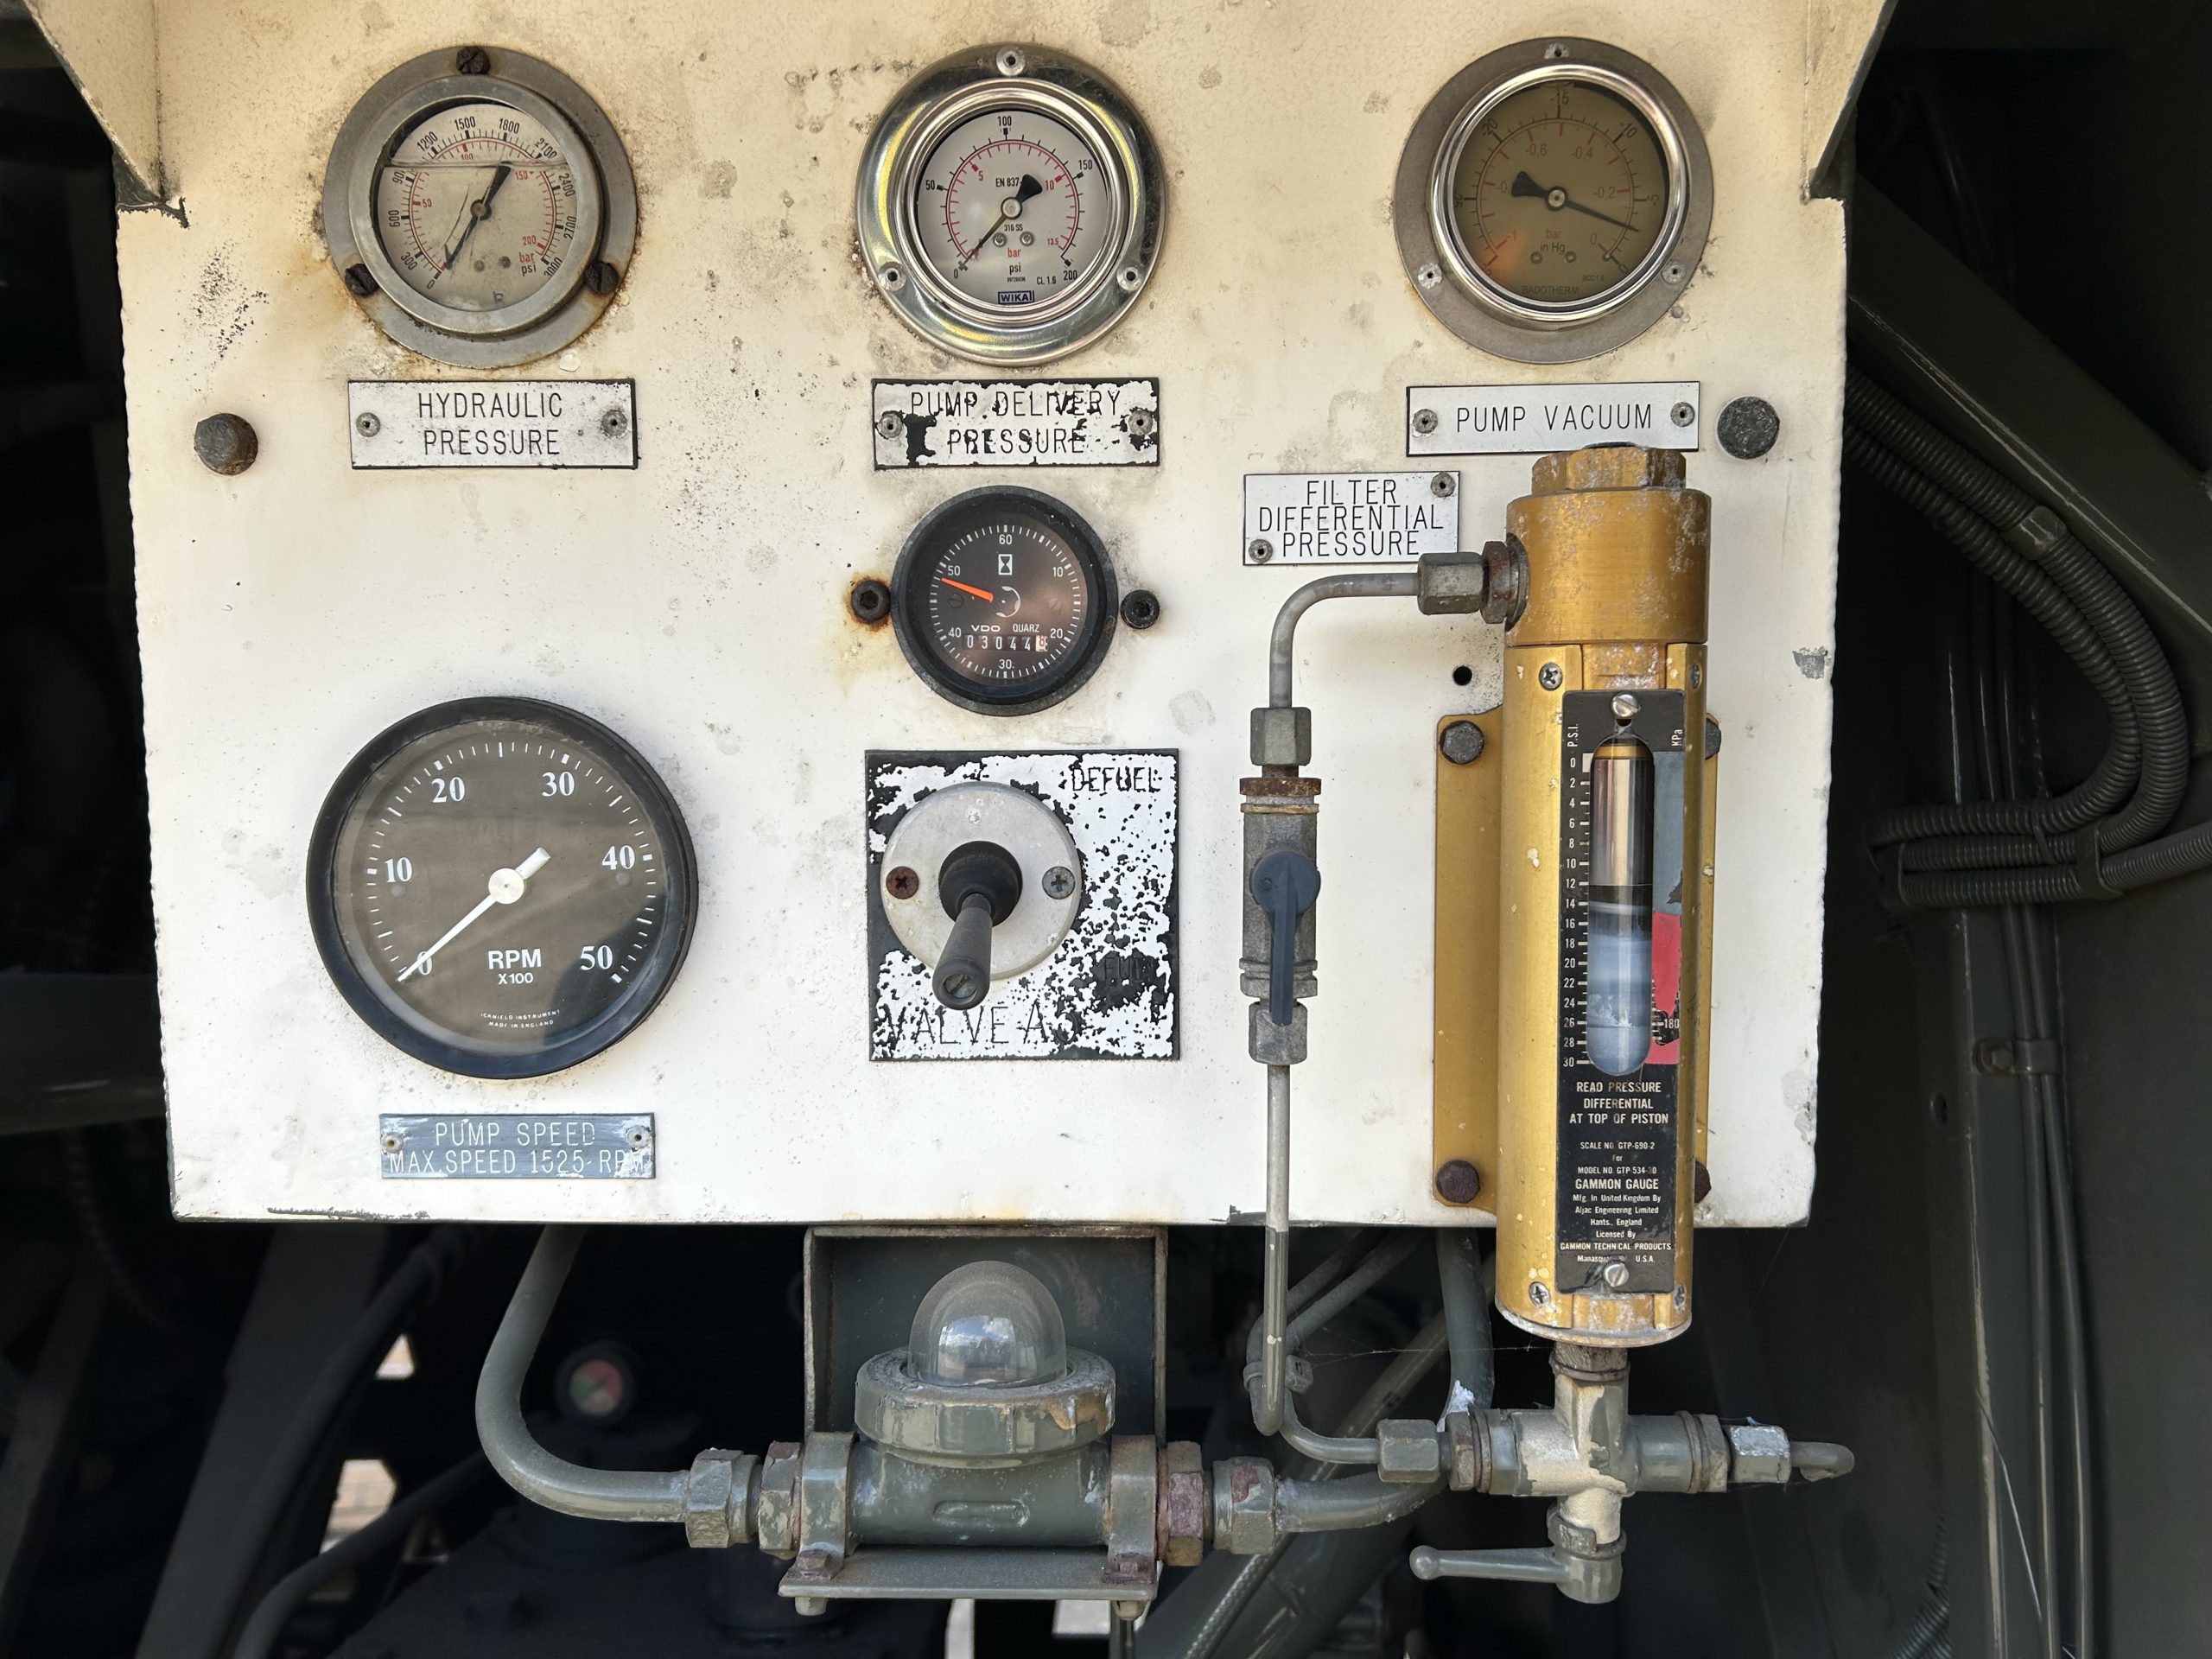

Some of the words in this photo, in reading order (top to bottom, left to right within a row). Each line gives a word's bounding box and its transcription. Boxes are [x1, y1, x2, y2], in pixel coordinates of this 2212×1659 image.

[454, 116, 476, 130] 1500
[499, 118, 520, 134] 1800
[997, 116, 1012, 127] 100
[416, 131, 438, 151] 1200
[535, 137, 557, 159] 2100
[1077, 159, 1093, 171] 150
[391, 168, 405, 185] 90
[515, 170, 528, 181] 150
[977, 170, 984, 181] 5
[558, 173, 575, 197] 2400
[925, 180, 936, 191] 50
[995, 177, 1005, 188] EN
[1044, 180, 1055, 191] 10
[422, 198, 432, 208] 50
[388, 209, 401, 227] 600
[563, 215, 577, 240] 2700
[1015, 223, 1024, 232] SS
[1546, 228, 1562, 240] bar
[1589, 232, 1598, 246] 0
[522, 234, 537, 246] 200
[1047, 238, 1059, 246] 13.5
[1007, 247, 1021, 258] bar
[1540, 242, 1550, 254] in
[1551, 242, 1567, 256] Hg
[400, 251, 418, 270] 300
[518, 251, 534, 264] bar
[521, 261, 537, 277] psi
[543, 257, 563, 277] 3000
[1009, 262, 1021, 276] psi
[953, 269, 959, 279] 0
[1063, 270, 1078, 281] 200
[426, 279, 435, 289] 0
[1036, 276, 1045, 285] CL
[1046, 276, 1057, 285] 1.6
[1522, 285, 1580, 295] BADOTHERM
[1000, 292, 1029, 303] WIKA
[418, 392, 563, 418] HYDRAULIC
[911, 391, 977, 417] PUMP
[995, 391, 1121, 417] DELIVERY
[1456, 405, 1527, 433] PUMP
[1544, 403, 1653, 431] VACUUM
[423, 429, 561, 455] PRESSURE
[949, 429, 1085, 454] PRESSURE
[1306, 479, 1397, 506] FILTER
[1258, 504, 1445, 533] DIFFERENTIAL
[999, 534, 1013, 545] 60
[1282, 530, 1421, 557] PRESSURE
[947, 565, 961, 576] 50
[1052, 566, 1064, 578] 10
[948, 626, 962, 638] 40
[970, 624, 1001, 632] VDO
[1012, 623, 1040, 633] QUARZ
[1050, 627, 1064, 639] 20
[999, 658, 1012, 670] 30
[1567, 723, 1579, 747] P.S.I.
[1671, 728, 1683, 747] KPa
[1570, 758, 1576, 768] 0
[542, 771, 575, 798] 30
[1071, 766, 1161, 792] DEFUEL
[1569, 778, 1576, 788] 2
[431, 777, 466, 804] 20
[1569, 798, 1575, 808] 4
[1569, 818, 1575, 829] 6
[1568, 838, 1574, 849] 8
[601, 845, 636, 871] 40
[1566, 858, 1576, 868] 10
[385, 856, 413, 883] 10
[1566, 878, 1576, 888] 12
[1565, 899, 1576, 908] 14
[1565, 918, 1575, 928] 16
[1565, 938, 1575, 948] 18
[416, 950, 433, 976] 0
[486, 948, 543, 969] RPM
[579, 945, 613, 971] 50
[1564, 957, 1576, 968] 20
[1563, 978, 1575, 988] 22
[1563, 998, 1575, 1007] 24
[521, 1019, 554, 1028] ENGLAND
[880, 1005, 1009, 1045] VALVE
[1563, 1018, 1575, 1027] 26
[1663, 1018, 1680, 1029] 180
[1563, 1038, 1575, 1047] 28
[1563, 1057, 1574, 1067] 30
[1576, 1082, 1603, 1093] READ
[1608, 1081, 1662, 1093] PRESSURE
[1583, 1097, 1654, 1109] DIFFERENTIAL
[1569, 1113, 1582, 1124] AT
[1587, 1113, 1608, 1124] TOP
[1613, 1113, 1626, 1124] OF
[1631, 1113, 1669, 1124] PISTON
[435, 1122, 500, 1146] PUMP
[517, 1122, 595, 1146] SPEED
[1580, 1141, 1602, 1150] SCALE
[1618, 1141, 1656, 1150] GTP-690-2
[530, 1149, 585, 1174] 1525
[599, 1149, 644, 1173] RPM
[1577, 1166, 1601, 1174] MODEL
[1575, 1179, 1622, 1190] GAMMON
[1625, 1179, 1659, 1190] GAUGE
[1591, 1193, 1598, 1202] In
[1600, 1193, 1622, 1202] United
[1622, 1193, 1650, 1203] Kingdom
[1652, 1193, 1662, 1203] By
[1574, 1205, 1592, 1215] Aljac
[1594, 1205, 1632, 1215] Engineering
[1635, 1205, 1659, 1214] Limited
[1616, 1217, 1643, 1227] England
[1627, 1230, 1637, 1239] By
